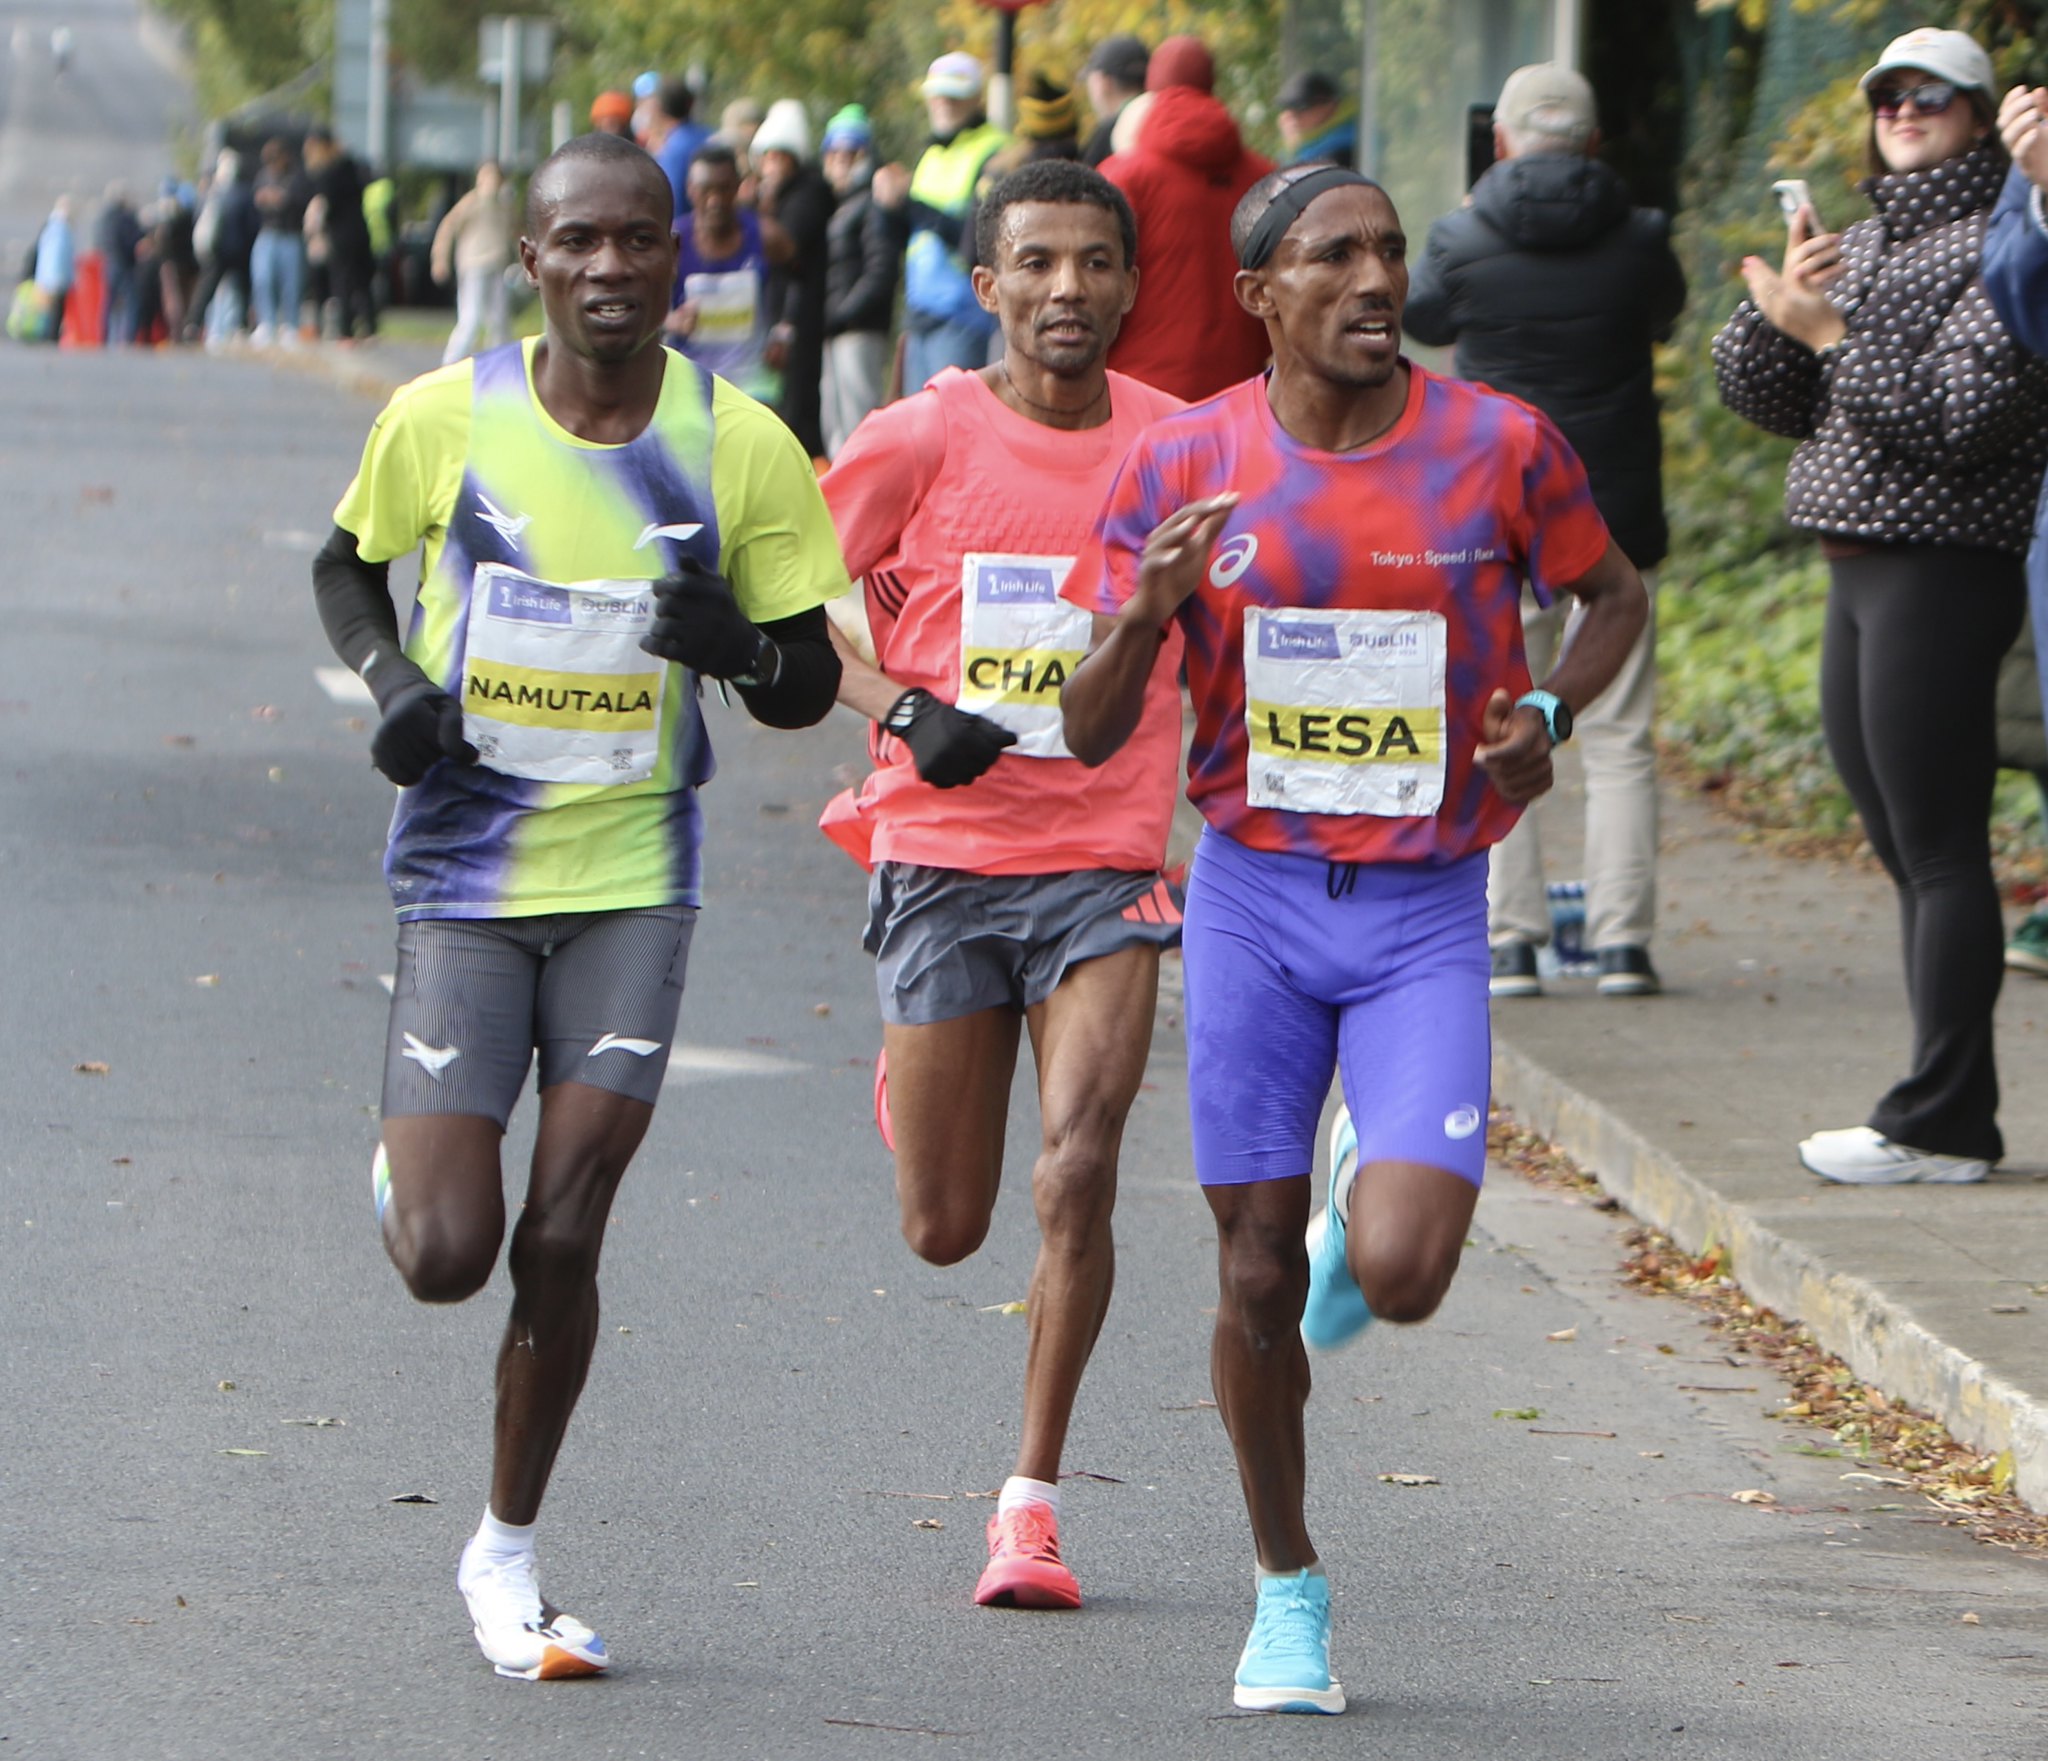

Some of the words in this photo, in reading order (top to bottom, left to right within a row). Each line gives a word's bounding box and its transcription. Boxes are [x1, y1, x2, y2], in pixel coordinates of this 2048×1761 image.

[1370, 549, 1413, 568] Tokyo
[1424, 548, 1466, 567] Speed
[1001, 580, 1023, 593] Irish
[1025, 580, 1046, 593] Life
[513, 595, 538, 608] Irish
[539, 596, 562, 611] Life
[581, 598, 648, 614] DUBLIN
[1350, 632, 1417, 648] DUBLIN
[968, 655, 1089, 693] CHA
[469, 675, 652, 712] NAMUTALA
[1268, 712, 1420, 757] LESA
